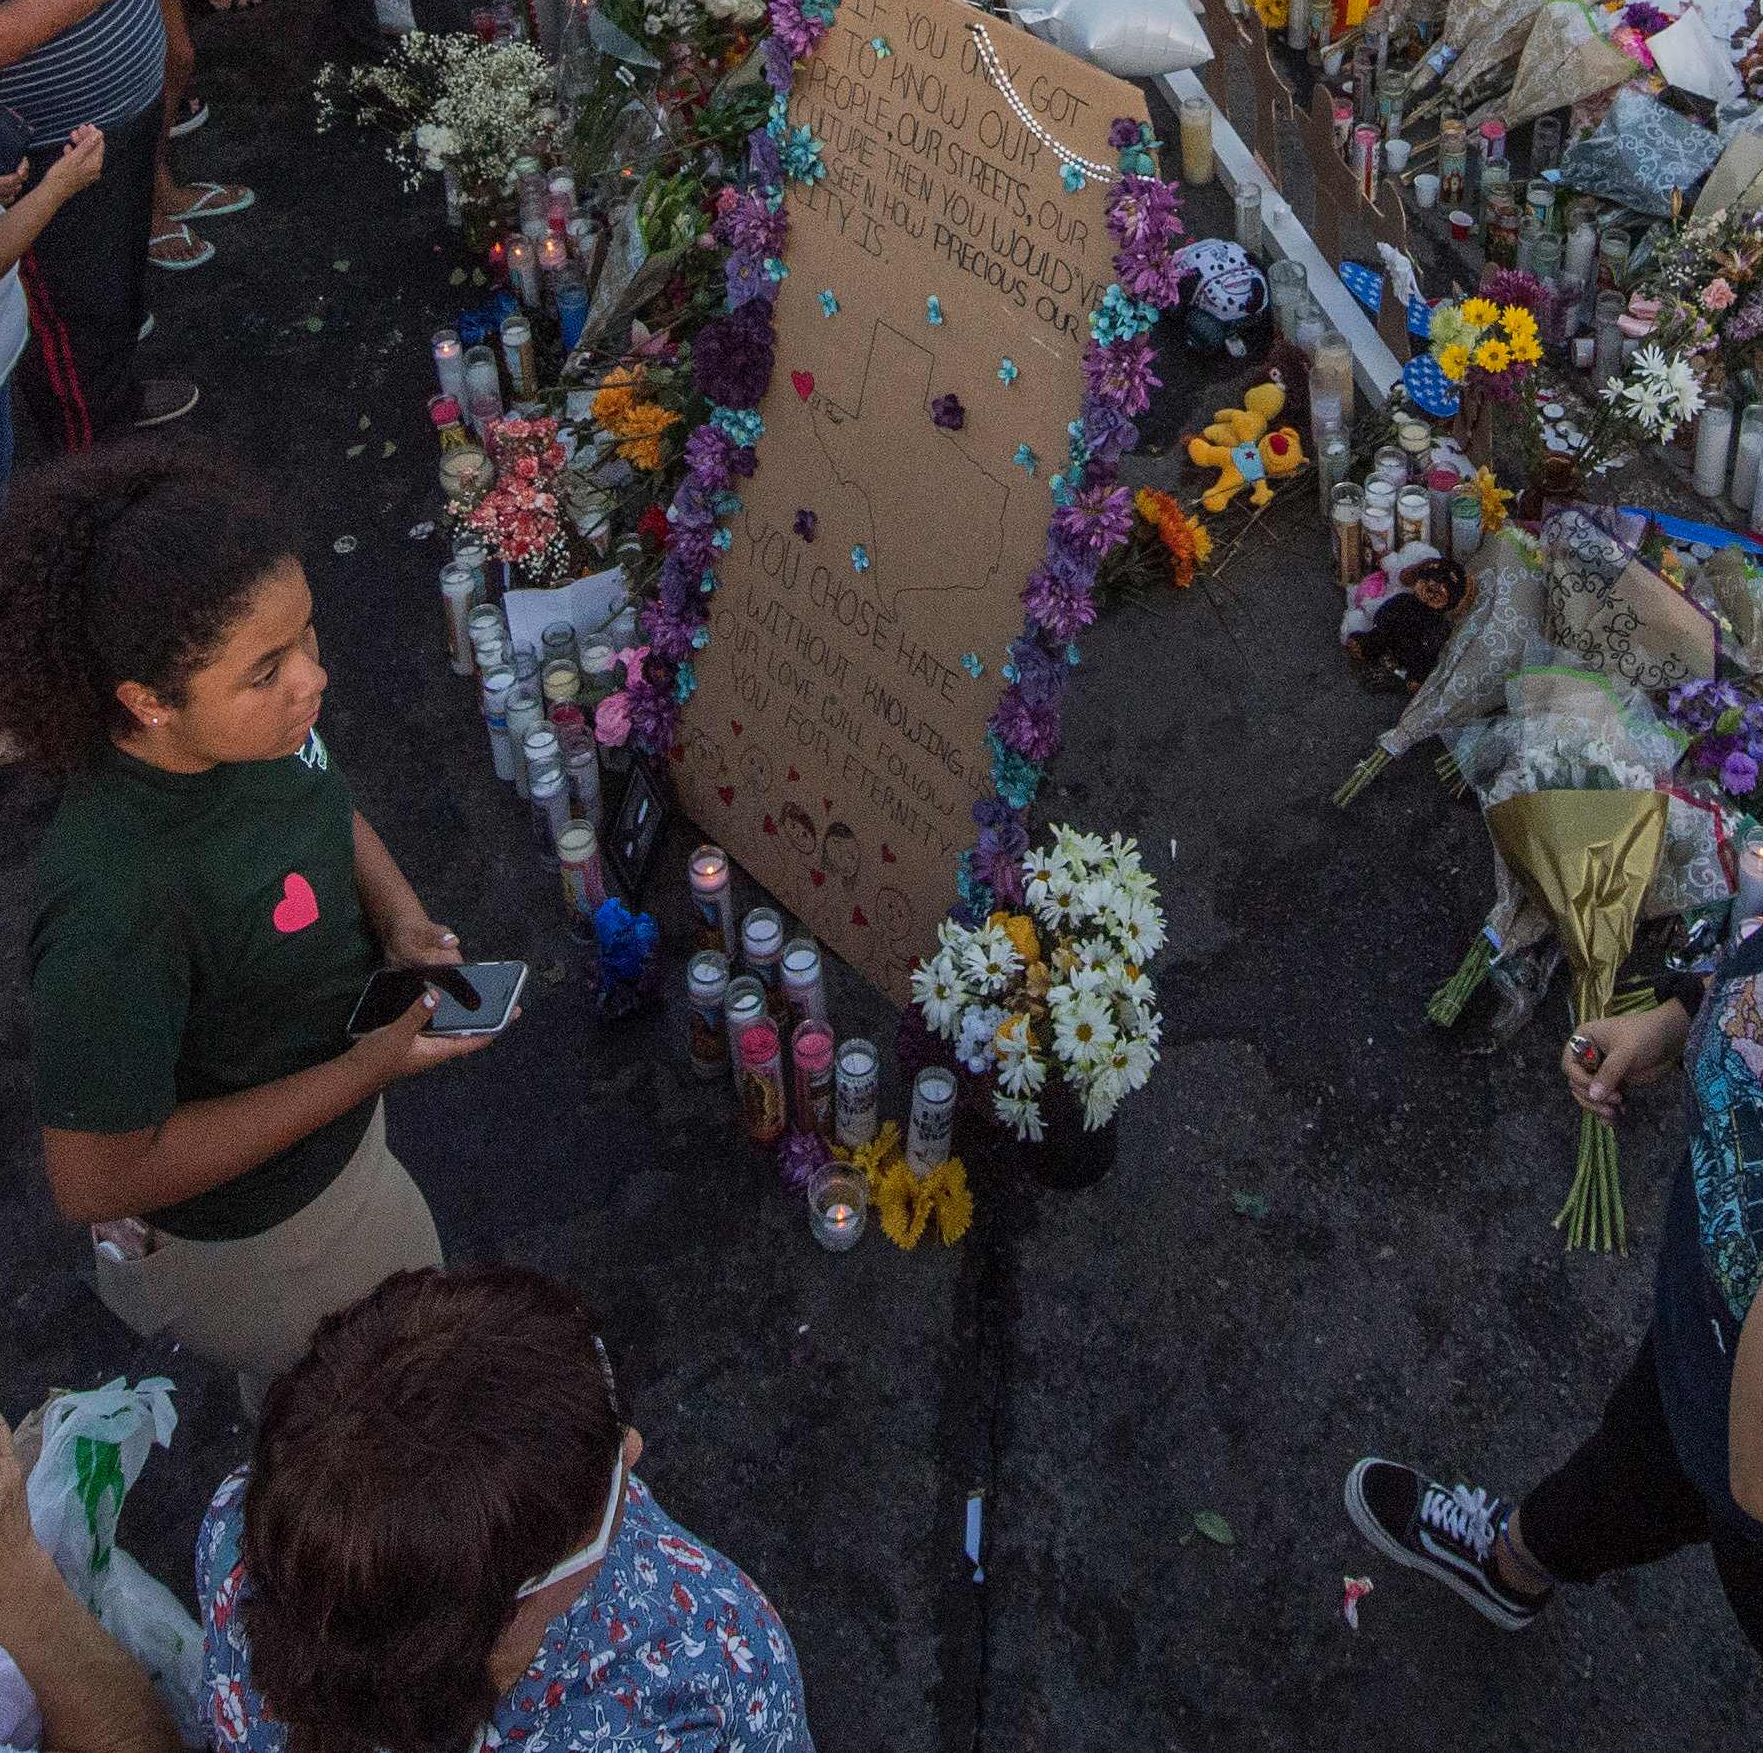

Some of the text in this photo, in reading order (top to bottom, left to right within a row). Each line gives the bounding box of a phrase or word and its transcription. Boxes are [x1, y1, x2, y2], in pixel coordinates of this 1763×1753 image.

[845, 27, 1043, 173] TO KNOW OUR
[906, 9, 951, 60] YOU
[1029, 76, 1091, 127] GOT
[793, 183, 855, 235] CITY
[795, 94, 878, 168] CULTURE
[885, 150, 933, 204] THEN
[940, 183, 987, 238] YOU
[897, 112, 943, 166] OUR
[1038, 200, 1089, 255] OUR
[828, 157, 1079, 342] SEEN HOW PRECIOUS OUR
[744, 511, 959, 707] YOU CHOSE HATE
[746, 585, 853, 690] WITHOUT
[863, 675, 964, 776] KNOWING
[715, 609, 955, 816] OUR LOVE WILL FOLLOW
[730, 655, 953, 854] YOU FOR ETERNITY
